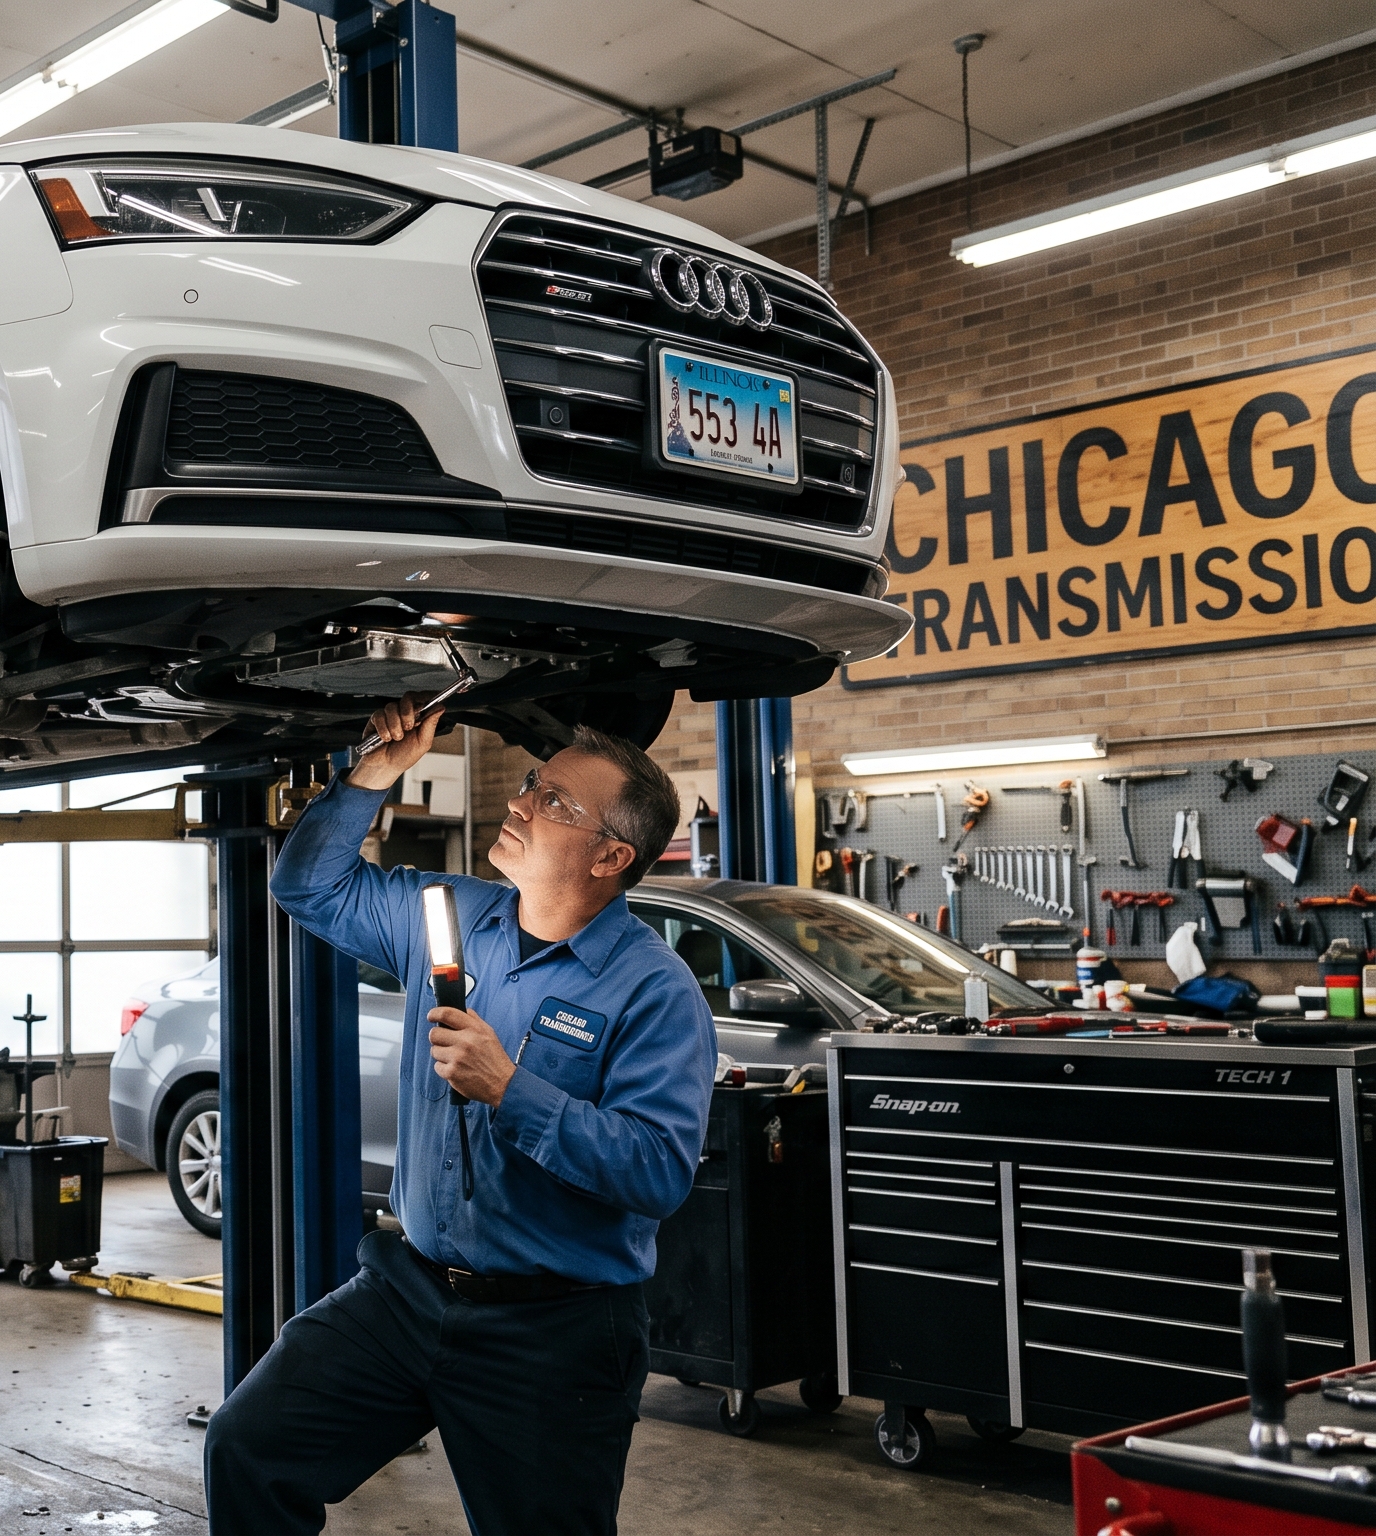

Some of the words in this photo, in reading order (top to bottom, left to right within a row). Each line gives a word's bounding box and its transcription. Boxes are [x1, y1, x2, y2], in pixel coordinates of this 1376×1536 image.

[689, 388, 737, 448] 553
[753, 402, 782, 459] 4A
[1215, 1068, 1276, 1084] TECH
[1281, 1070, 1292, 1085] 1
